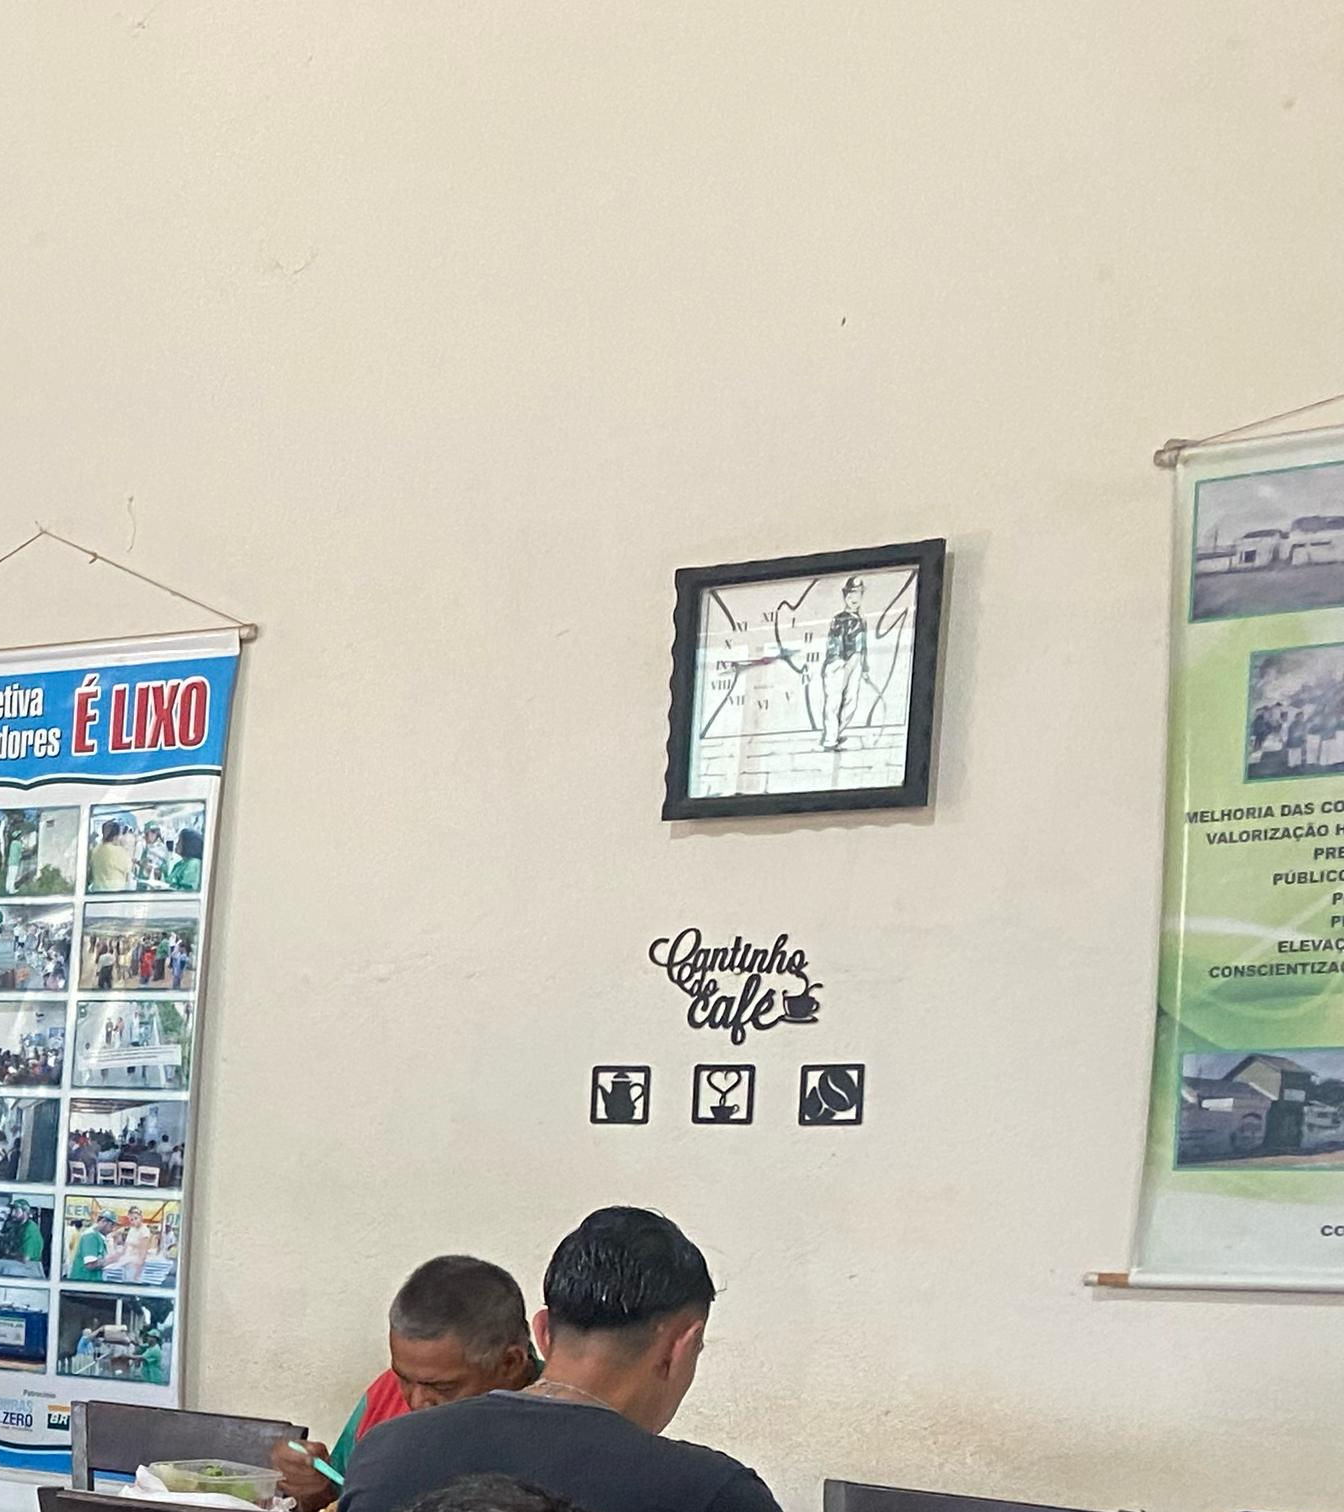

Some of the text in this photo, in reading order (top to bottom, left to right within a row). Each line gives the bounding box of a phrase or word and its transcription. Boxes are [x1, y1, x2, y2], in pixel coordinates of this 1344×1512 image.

[72, 673, 210, 757] É LIXO
[1186, 805, 1275, 824] MELHORIA
[1280, 802, 1315, 817] DAS
[1206, 822, 1329, 845] VALORIZAÇÃO
[648, 927, 808, 978] Cantinho
[687, 973, 783, 1046] café
[2, 1411, 33, 1428] ZERO
